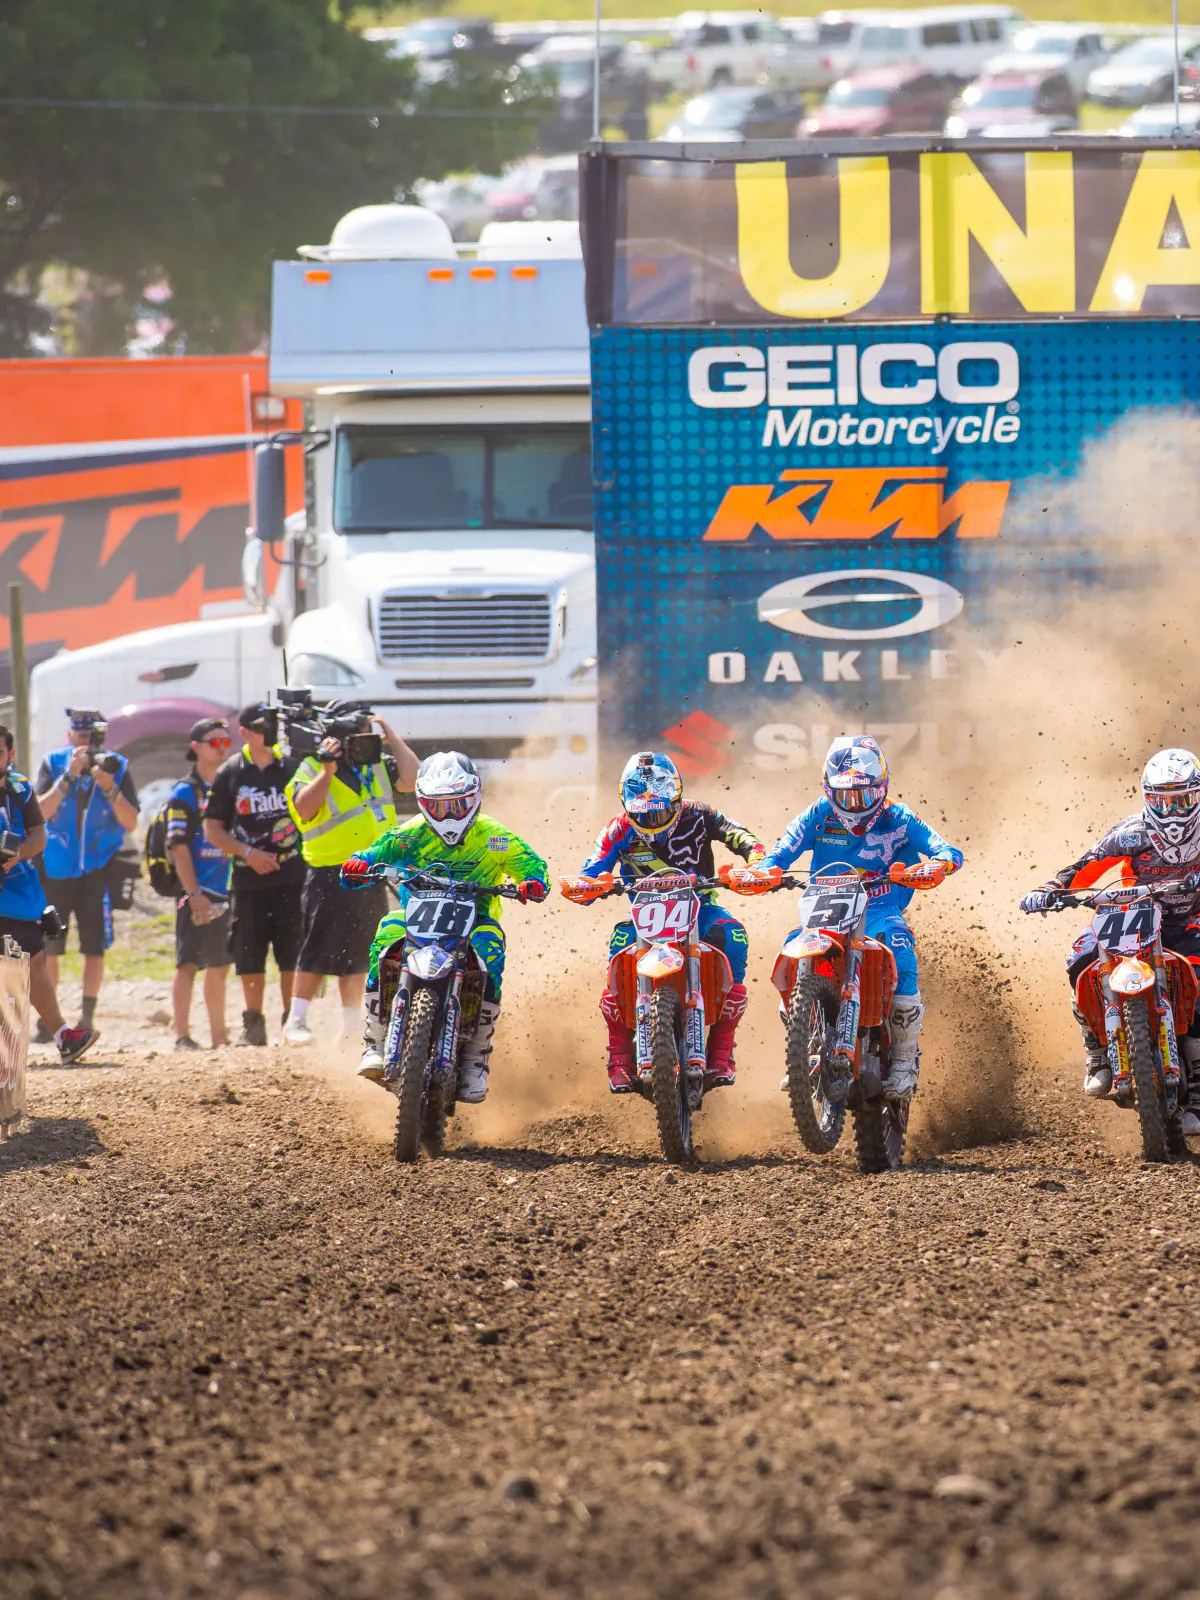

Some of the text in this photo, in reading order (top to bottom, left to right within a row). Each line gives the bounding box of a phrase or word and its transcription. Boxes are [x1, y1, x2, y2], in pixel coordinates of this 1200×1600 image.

[687, 341, 1019, 409] GEICO
[762, 405, 1021, 454] Motorcycle
[703, 466, 1011, 542] KTM
[753, 722, 978, 772] SUZU
[631, 802, 665, 811] Red Bull
[426, 891, 446, 899] LUCAS
[640, 879, 690, 889] RENTHA
[669, 892, 679, 900] OIL
[406, 900, 474, 936] 48
[638, 900, 691, 938] 94
[807, 894, 855, 929] 5
[1097, 909, 1154, 949] 44
[389, 997, 406, 1054] NLOP
[639, 1007, 647, 1056] DNLOP
[845, 1002, 854, 1042] DUNLOP
